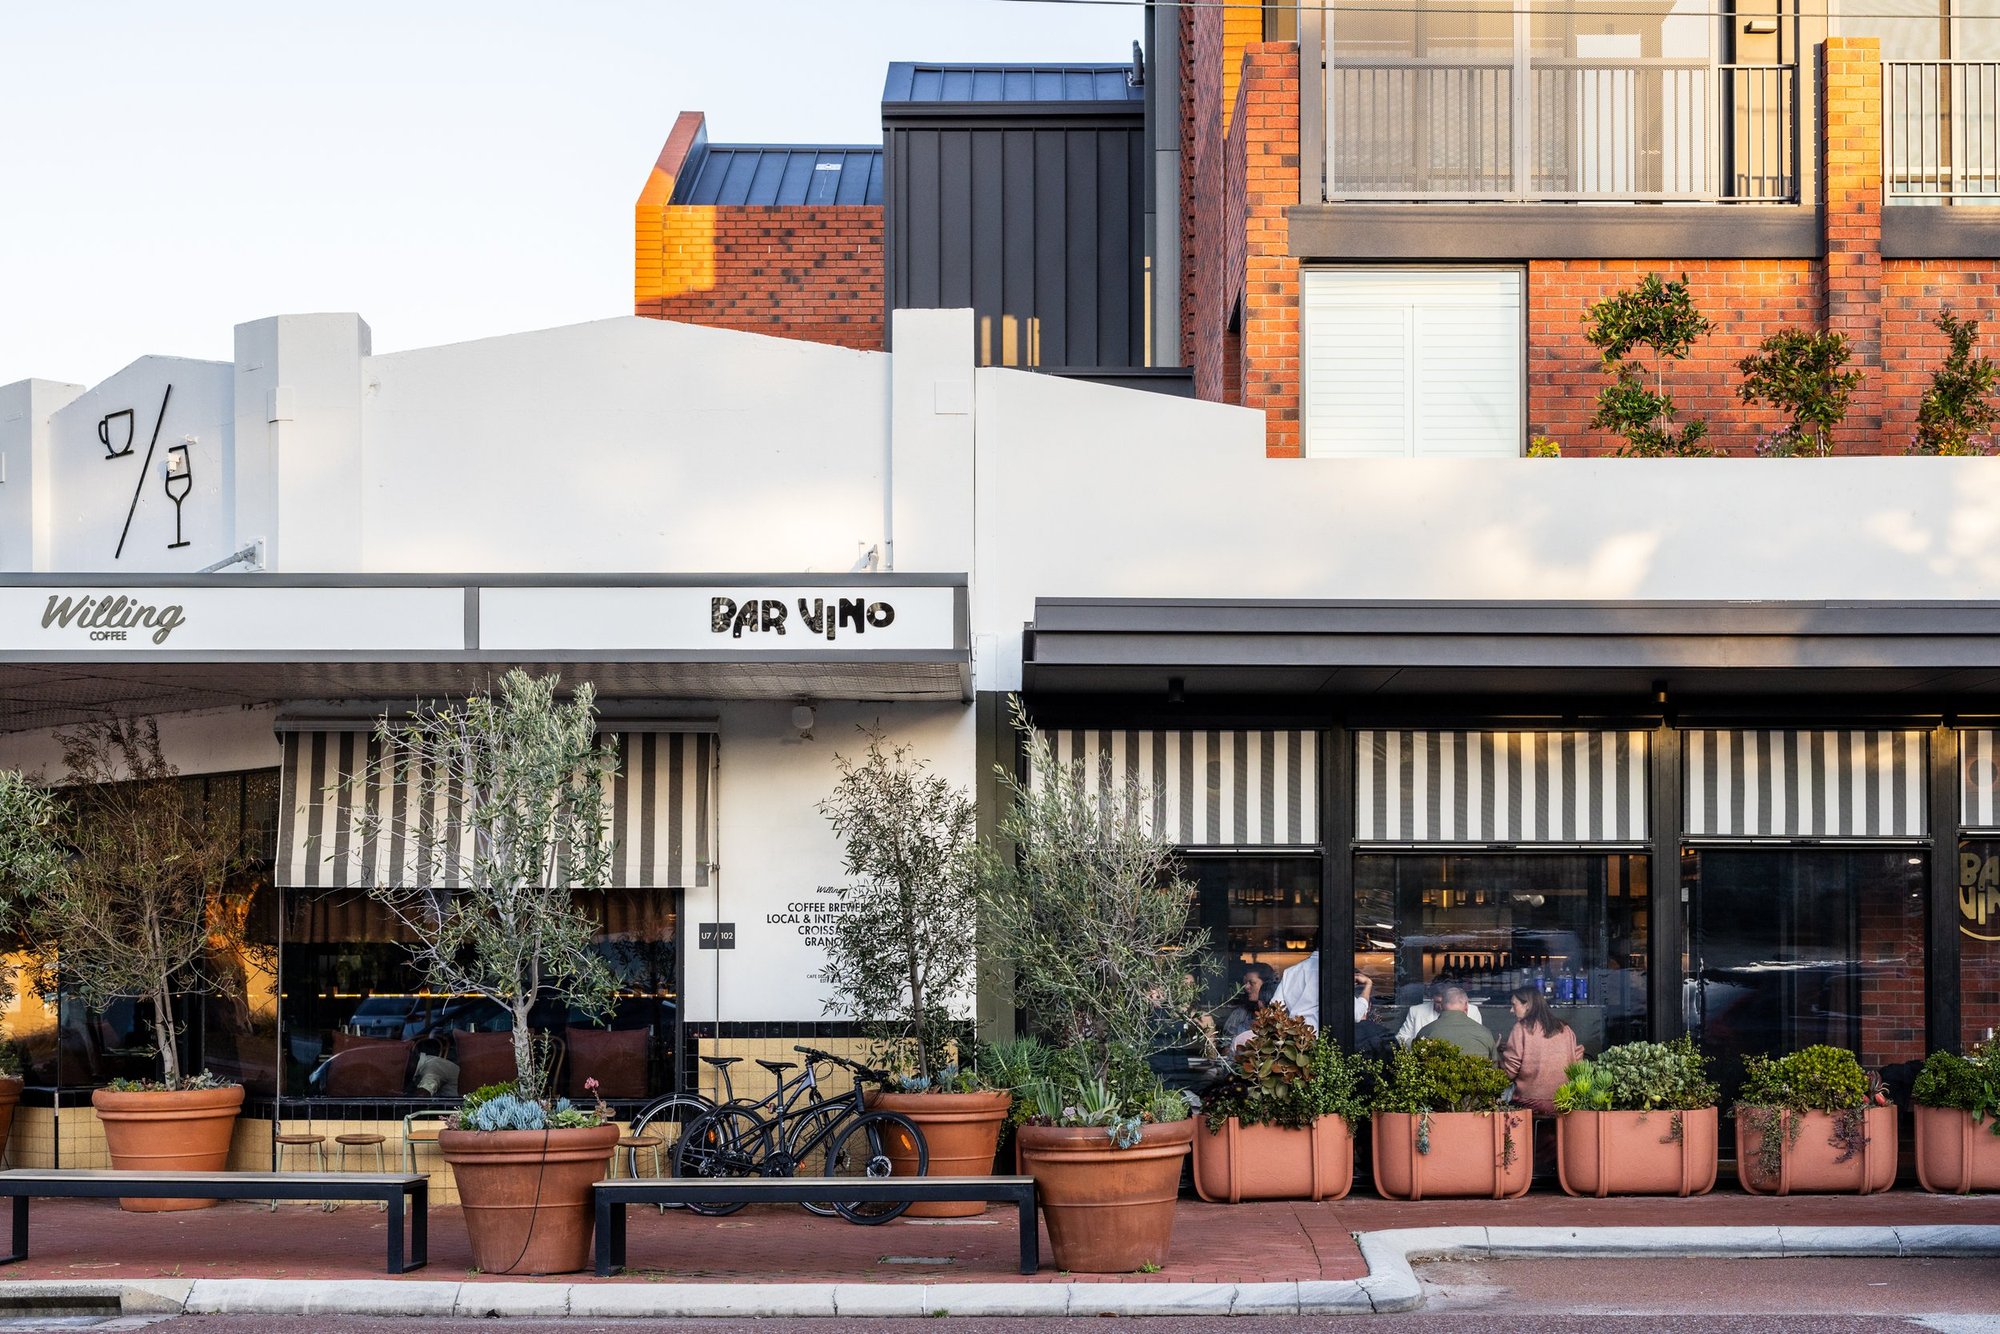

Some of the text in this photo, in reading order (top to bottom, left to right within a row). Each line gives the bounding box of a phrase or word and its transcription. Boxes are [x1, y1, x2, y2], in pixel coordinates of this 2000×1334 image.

[41, 594, 186, 645] Willing
[711, 597, 895, 640] BAR VINO
[89, 631, 127, 641] COFFEE
[787, 902, 826, 912] COFFEE
[766, 914, 800, 924] LOCAL
[803, 914, 811, 924] &
[701, 932, 711, 940] U7
[720, 932, 734, 940] 102
